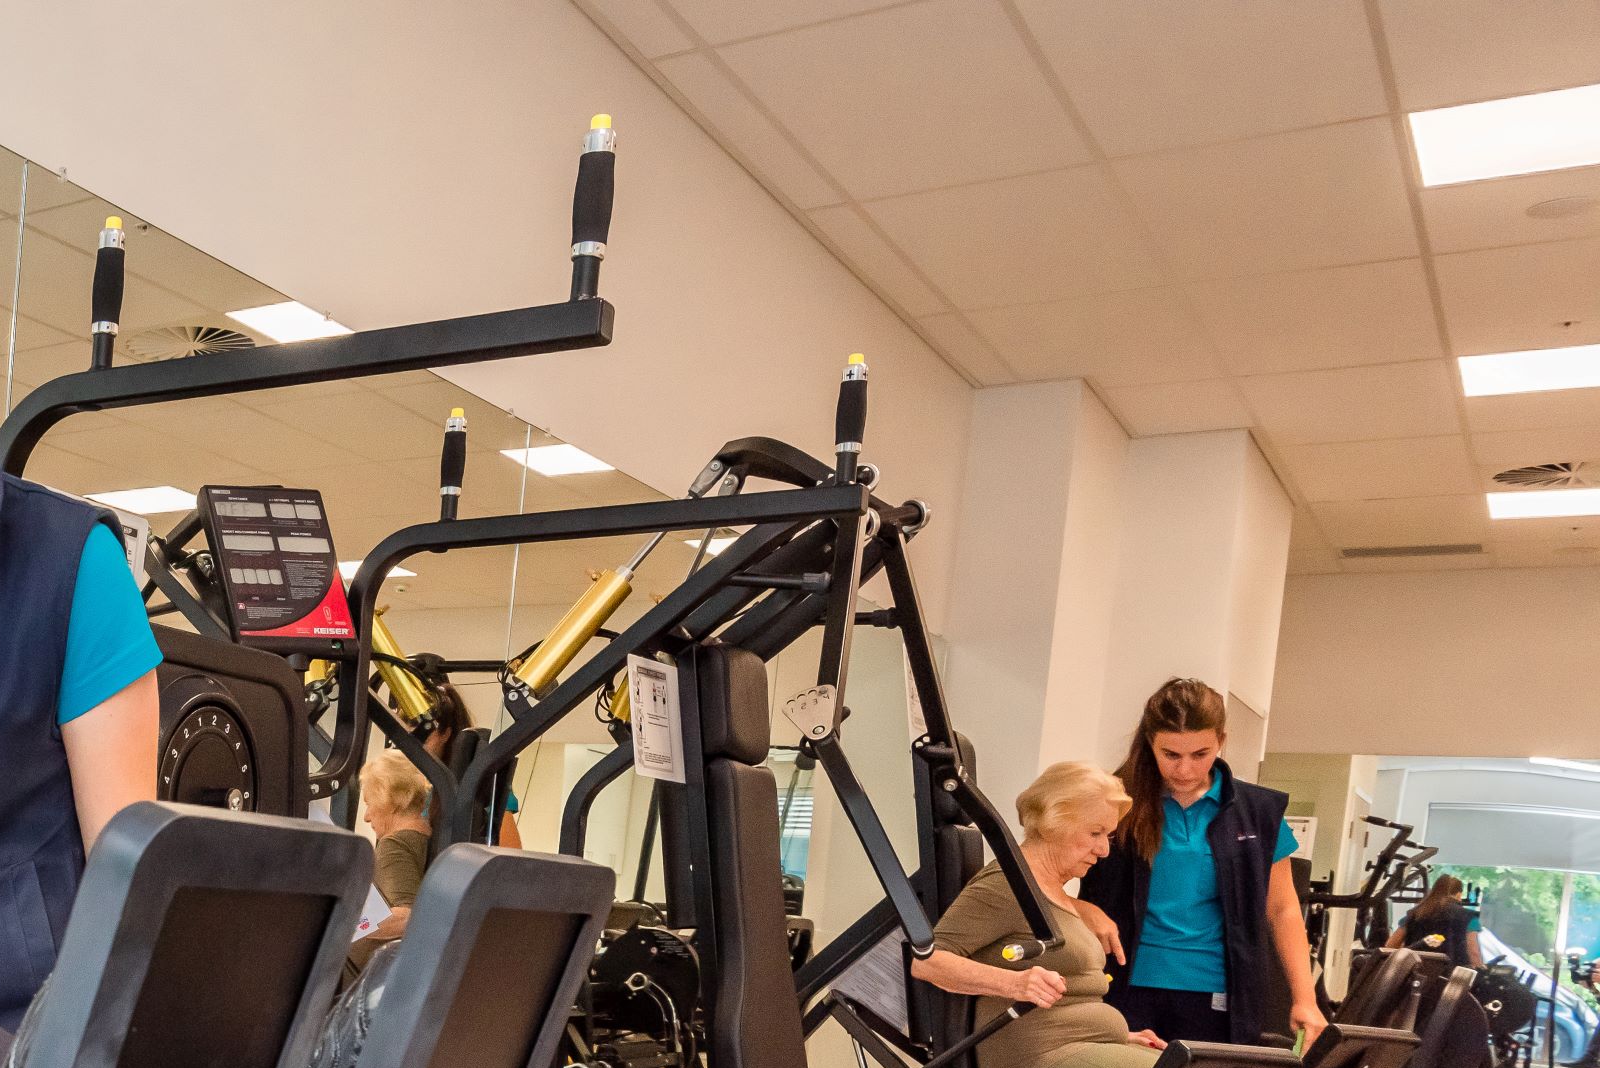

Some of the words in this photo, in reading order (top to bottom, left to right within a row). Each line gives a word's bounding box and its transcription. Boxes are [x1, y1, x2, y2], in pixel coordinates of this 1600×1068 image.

[313, 627, 349, 635] KEISER
[183, 728, 190, 739] 2
[197, 716, 202, 727] 1
[211, 714, 218, 726] 2
[224, 723, 231, 734] 3
